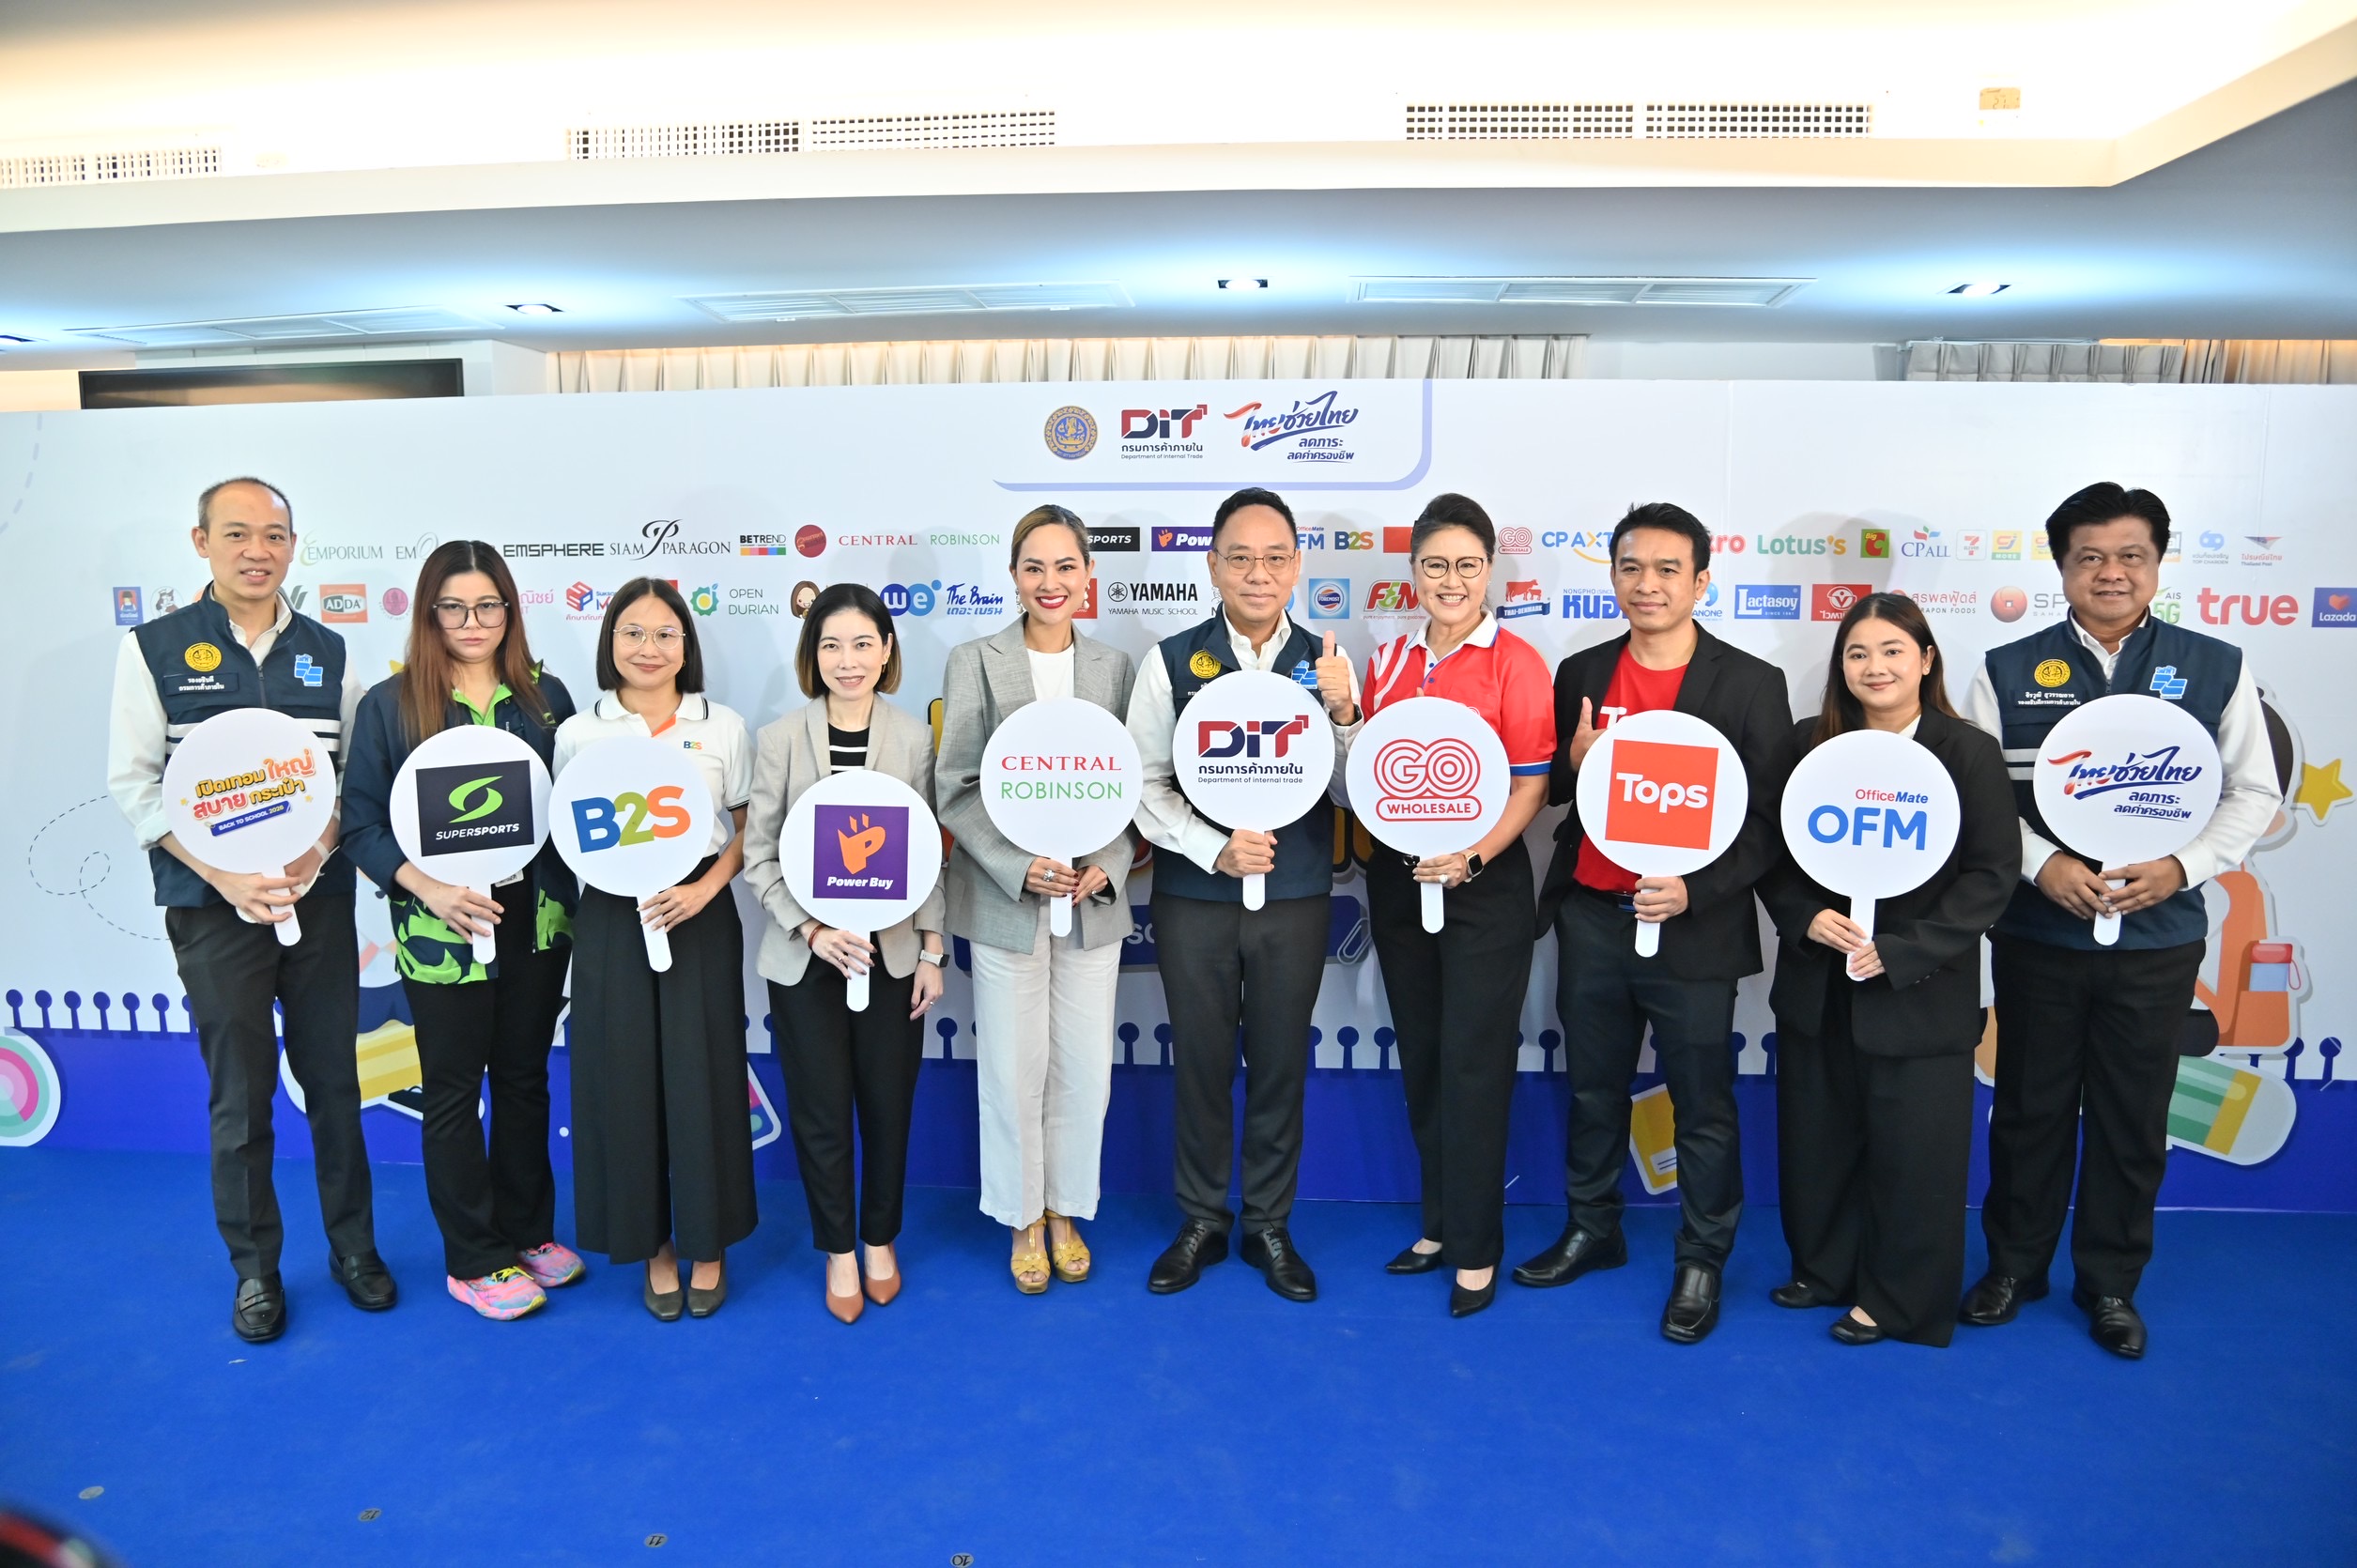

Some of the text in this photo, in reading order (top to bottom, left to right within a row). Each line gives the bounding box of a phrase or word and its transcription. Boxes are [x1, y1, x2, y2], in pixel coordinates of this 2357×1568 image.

[1121, 442, 1204, 453] กรมการค้าภายใน
[1299, 438, 1343, 449] ลดภาระ
[1286, 449, 1354, 461] ลดค่าครองชีพ
[740, 535, 787, 545] BETREND
[839, 535, 918, 546] CENTRAL
[930, 533, 1000, 546] ROBINSON
[1087, 535, 1132, 544] SPORTS
[1175, 533, 1213, 546] Pow
[1296, 533, 1325, 550] FM
[1334, 531, 1374, 550] B2S
[1499, 527, 1533, 547] GO
[1541, 531, 1614, 548] CP AXT
[1757, 534, 1847, 555] Lotus's
[308, 545, 383, 561] EMPORIUM
[503, 544, 605, 558] EMSPHERE
[609, 543, 645, 556] SIAM
[662, 541, 732, 555] PARAGON
[729, 588, 763, 599] OPEN
[947, 582, 1004, 606] The Brain
[1130, 583, 1198, 602] YAMAHA
[2164, 592, 2182, 600] AIS
[326, 598, 362, 610] ADDA
[728, 604, 779, 615] DURIAN
[1737, 589, 1798, 616] Lactasoy
[2197, 587, 2299, 626] true
[2319, 611, 2356, 622] Lazada
[178, 683, 225, 692] กรมการค้าภายใน
[684, 741, 703, 750] B2S
[1001, 756, 1122, 772] CENTRAL
[1198, 761, 1303, 775] กรมการค้าภายใน
[1374, 738, 1481, 799] GO
[195, 748, 316, 798] เปิดเทอม ใหญ่
[1198, 776, 1303, 785] Department of internal trade
[1001, 781, 1122, 800] ROBINSON
[1616, 772, 1708, 814] Tops
[1855, 788, 1929, 804] OfficeMate
[2128, 791, 2180, 805] ลดภาระ
[193, 777, 306, 820] สบาย กระเป๋า
[1387, 803, 1471, 815] WHOLESALE
[2113, 804, 2193, 819] ลดค่าครองชีพ
[218, 821, 236, 831] BACK
[244, 810, 269, 823] SCHOOL
[571, 785, 691, 853] B2S
[436, 822, 520, 841] SUPERSPORTS
[1808, 805, 1928, 851] OFM
[826, 876, 894, 890] Power Buy
